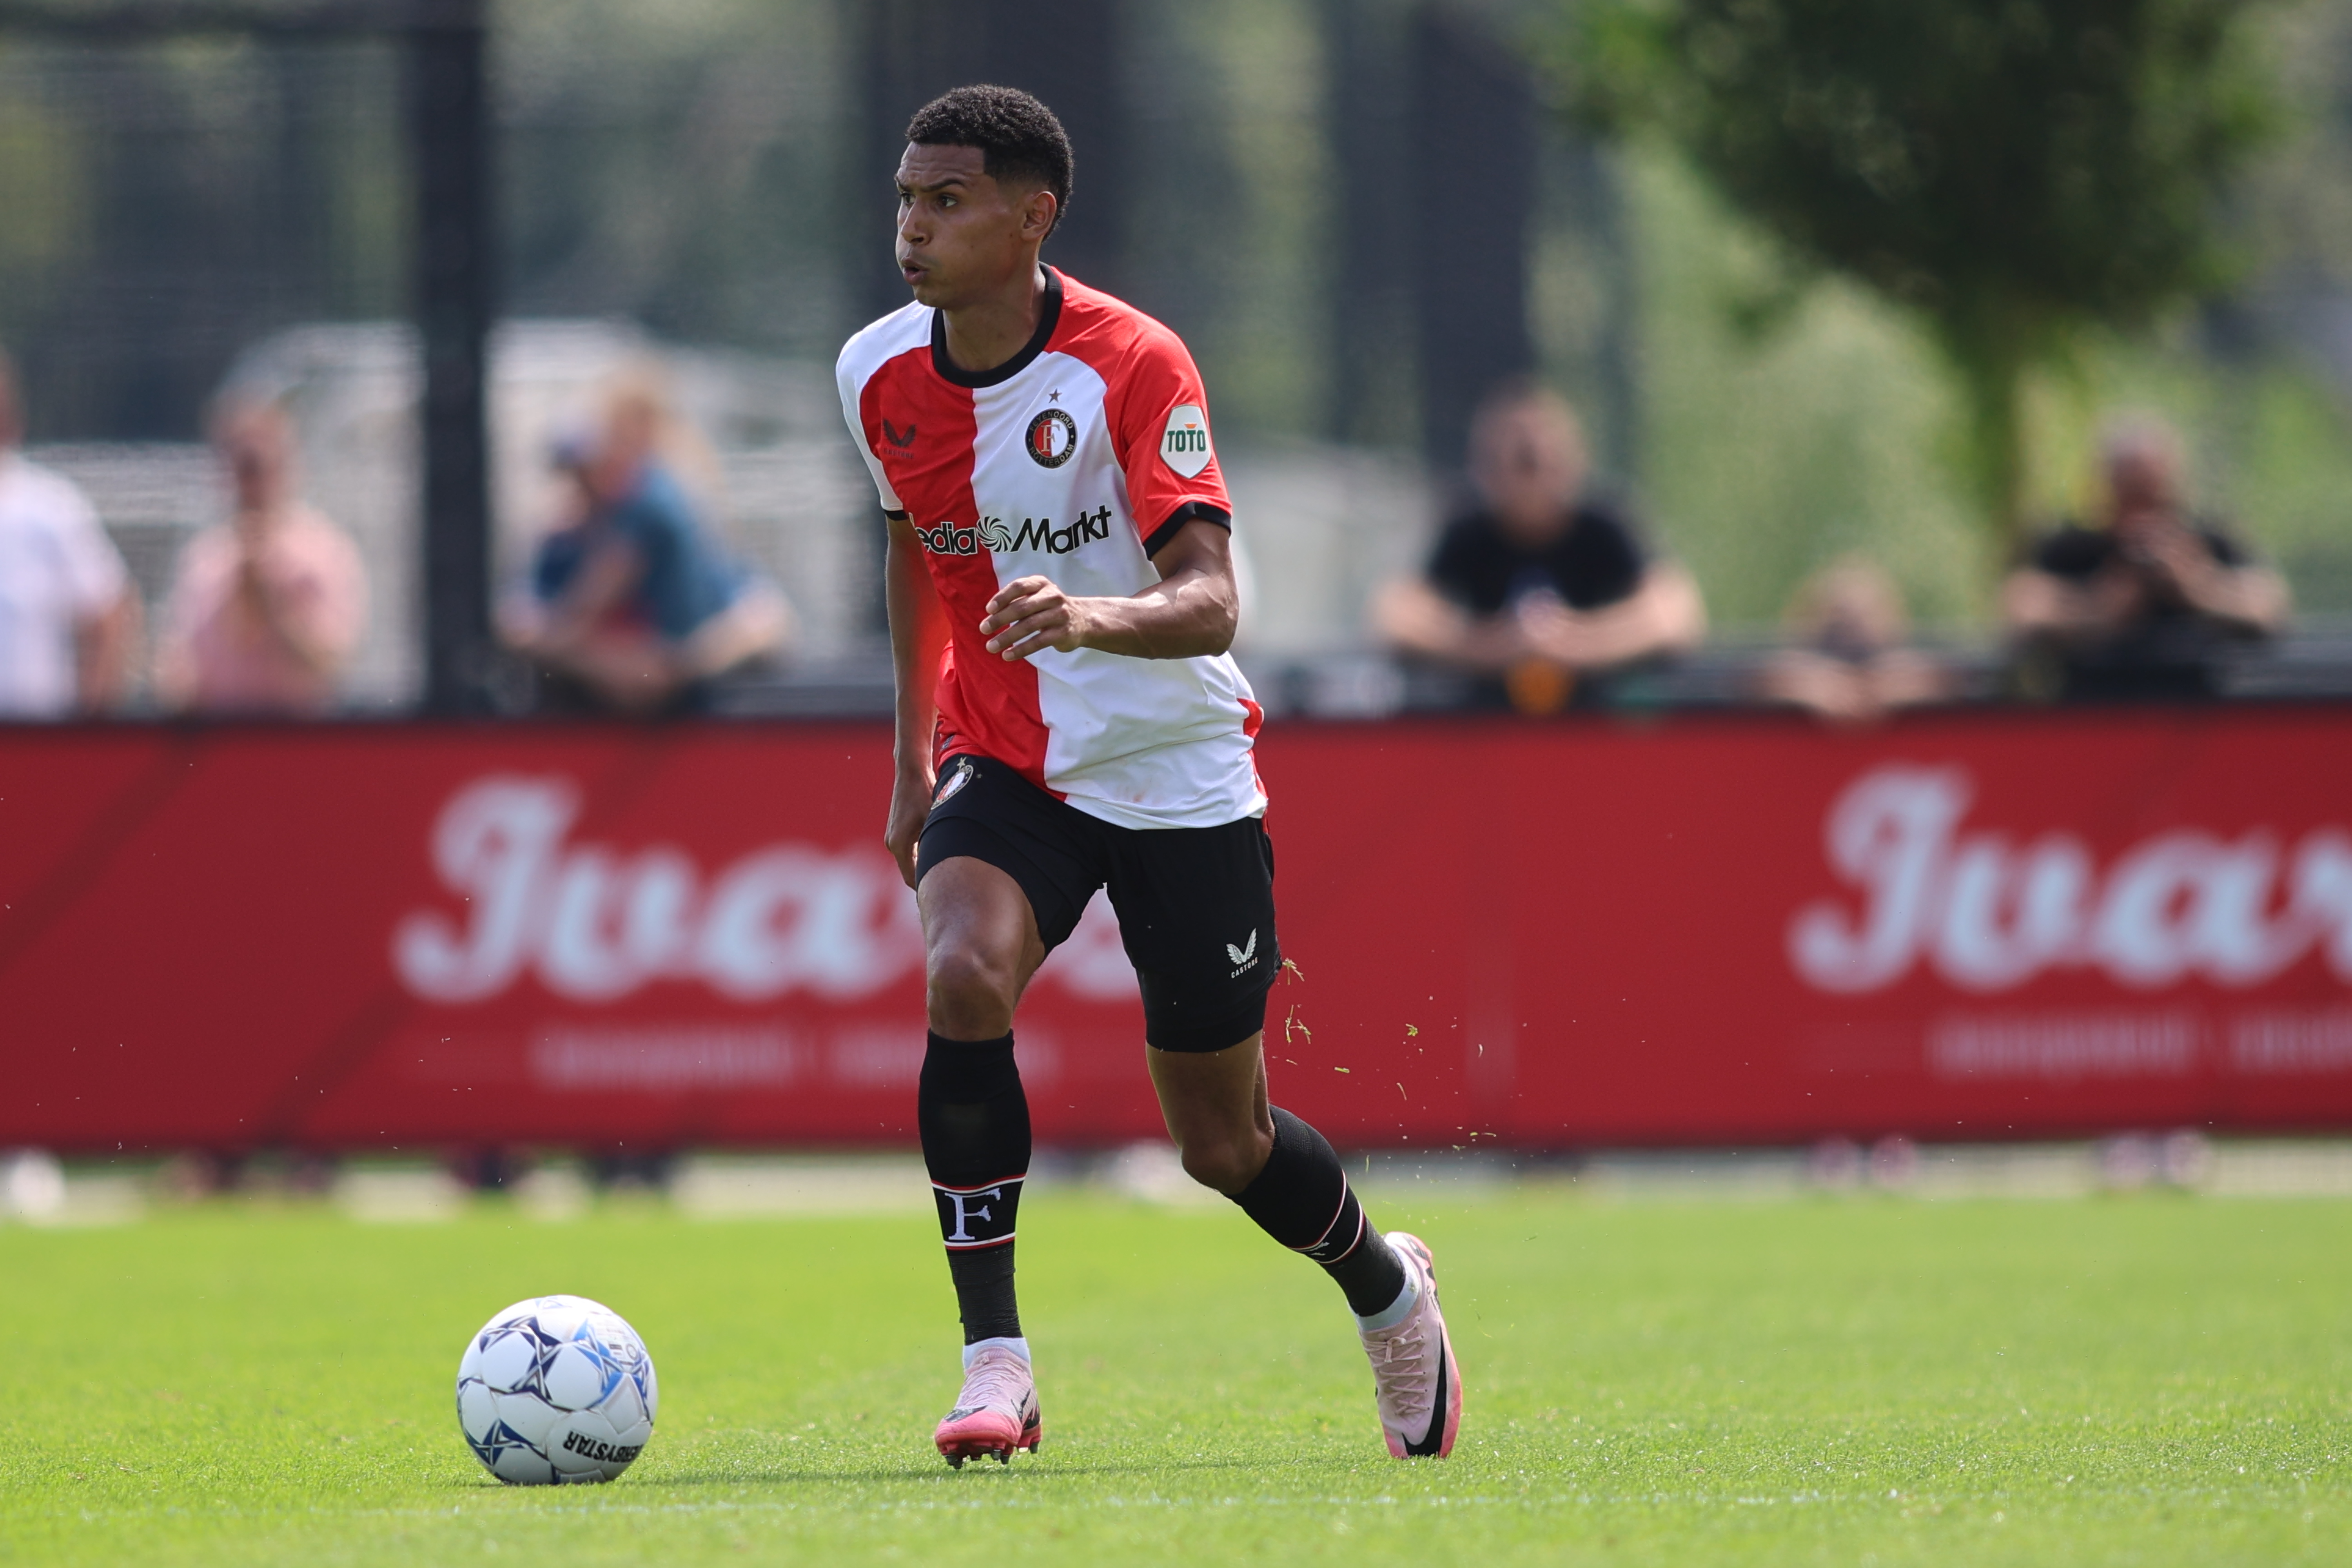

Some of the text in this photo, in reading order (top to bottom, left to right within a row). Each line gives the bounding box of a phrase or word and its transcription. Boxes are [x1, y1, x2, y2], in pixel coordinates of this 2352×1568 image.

[1029, 411, 1074, 431] FEYENOORD
[1040, 424, 1061, 452] F
[1167, 430, 1206, 452] TOTO
[1029, 444, 1074, 466] ROTTERDAM
[909, 512, 978, 556] edia
[1231, 956, 1258, 979] CASTORE
[944, 1187, 1001, 1240] F
